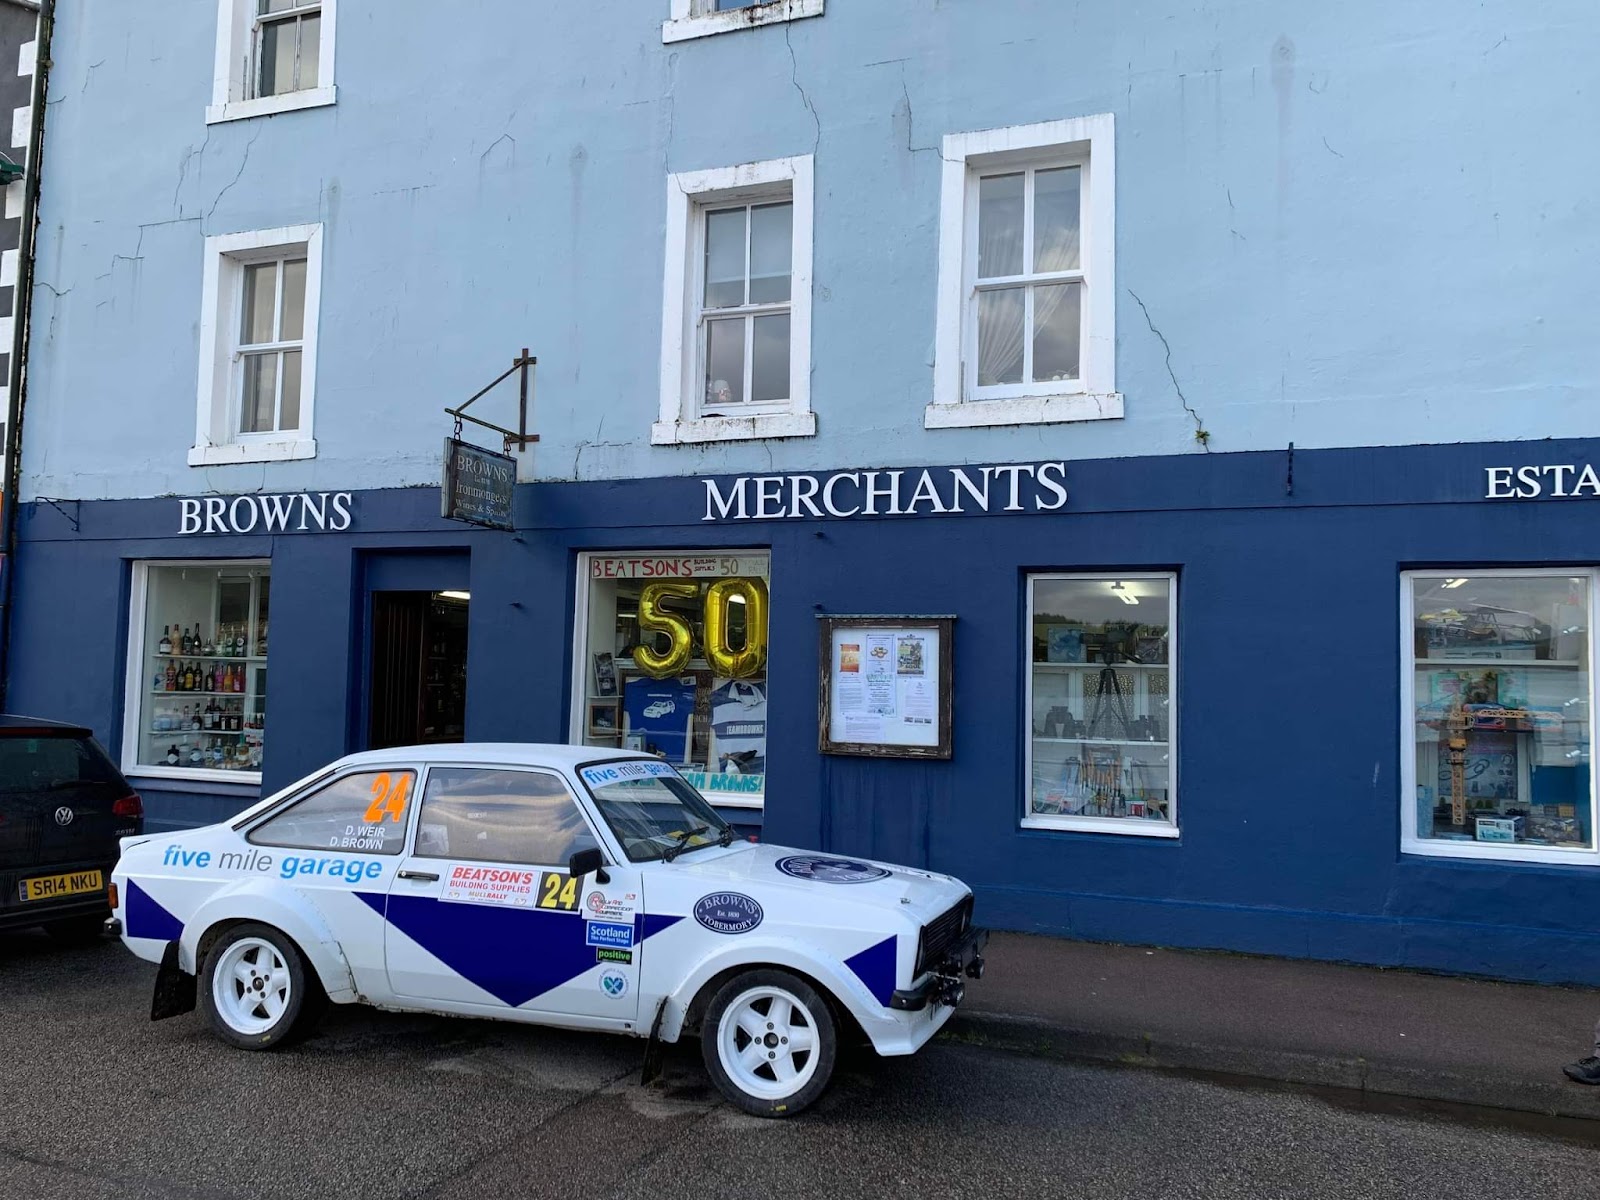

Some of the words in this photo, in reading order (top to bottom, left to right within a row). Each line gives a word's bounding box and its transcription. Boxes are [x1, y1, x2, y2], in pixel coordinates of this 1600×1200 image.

[456, 454, 508, 483] BROWNS
[1484, 463, 1600, 499] ESTA
[701, 461, 1069, 521] MERCHANTS
[177, 492, 352, 535] BROWNS
[592, 558, 693, 577] BEATSON'S
[720, 558, 740, 576] 50
[633, 579, 768, 680] 50
[584, 768, 619, 784] five
[618, 762, 646, 777] mile
[710, 773, 764, 793] BROWNS!
[362, 772, 411, 824] 24
[163, 844, 211, 868] five
[218, 849, 273, 872] mile
[280, 856, 383, 883] garage
[33, 880, 67, 896] SR14
[70, 871, 98, 891] NKU
[449, 880, 489, 891] BUILDING
[491, 883, 531, 894] SUPPLIES
[452, 866, 533, 885] BEATSON'S
[541, 873, 578, 910] 24
[590, 925, 630, 939] Scotland
[704, 914, 752, 931] TOBERMORY
[598, 950, 631, 961] positive
